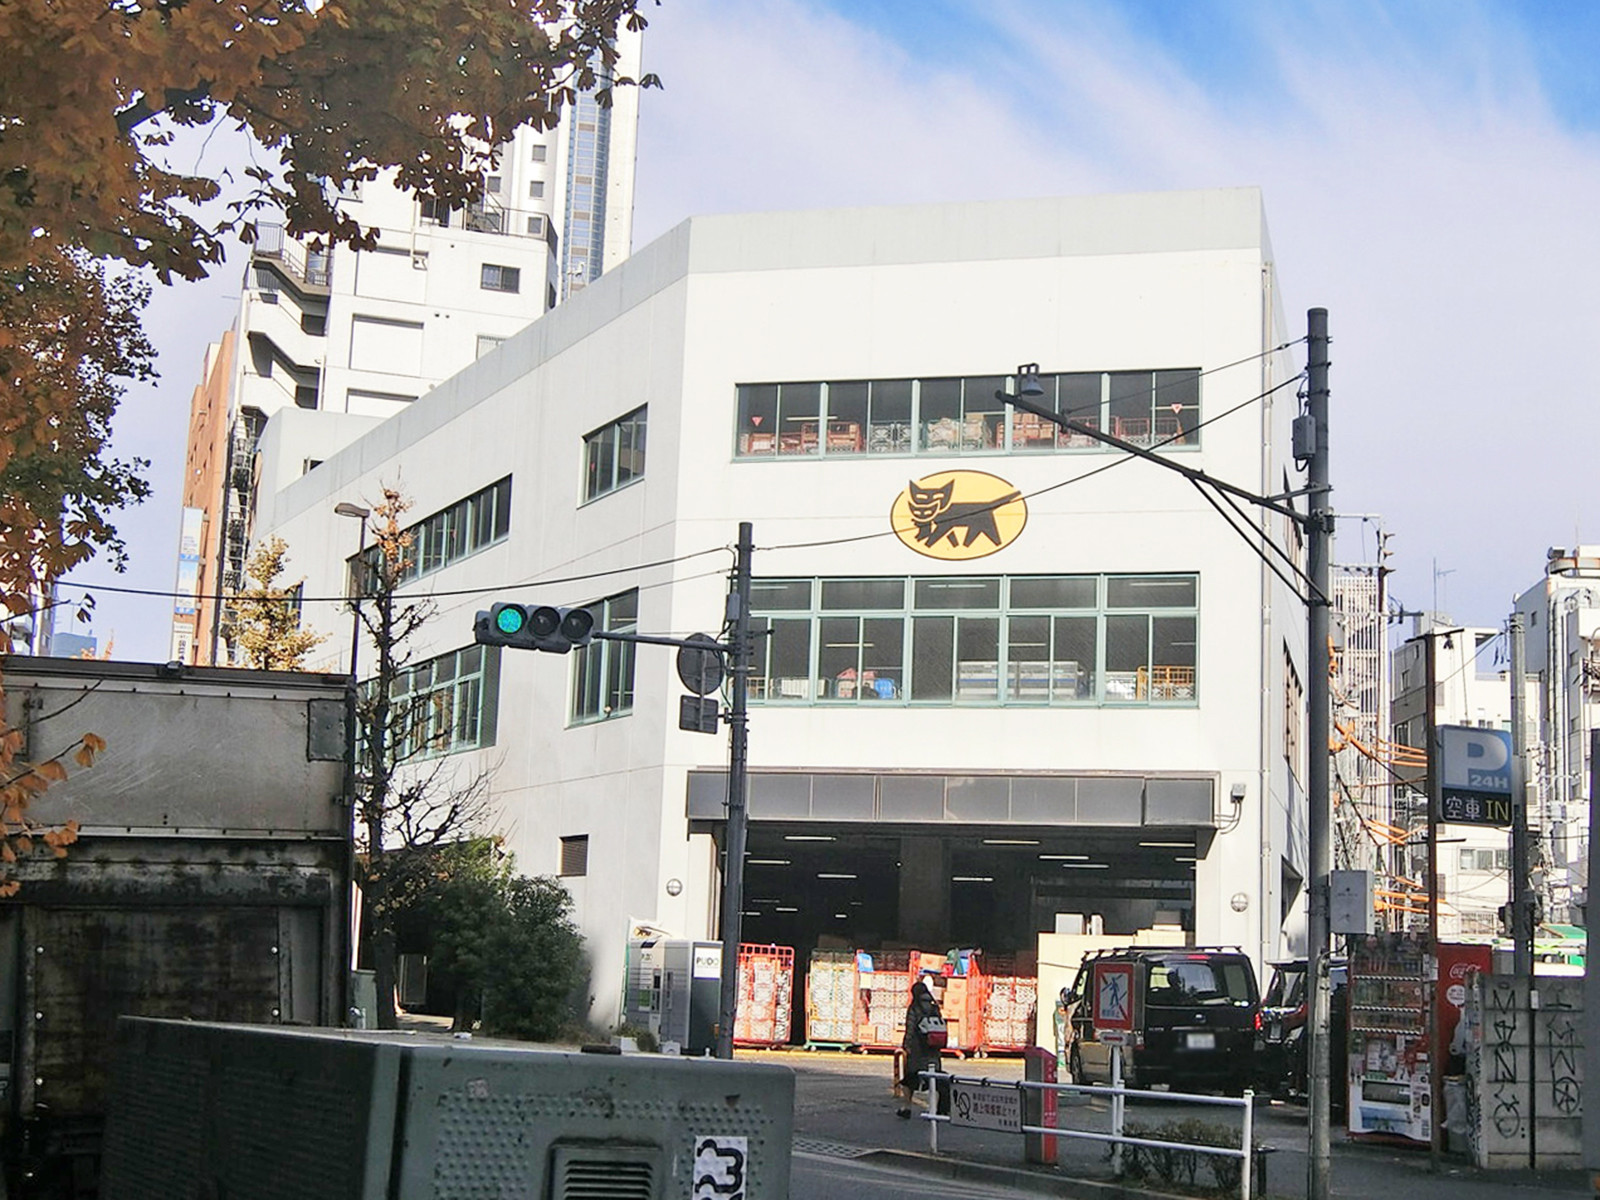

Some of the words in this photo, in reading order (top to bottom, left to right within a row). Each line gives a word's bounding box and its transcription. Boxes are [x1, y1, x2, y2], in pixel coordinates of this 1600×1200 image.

[1443, 729, 1508, 787] P
[1471, 774, 1509, 789] 24H
[1446, 796, 1480, 820] 空車
[1486, 800, 1509, 821] IN
[696, 957, 719, 966] PUDO
